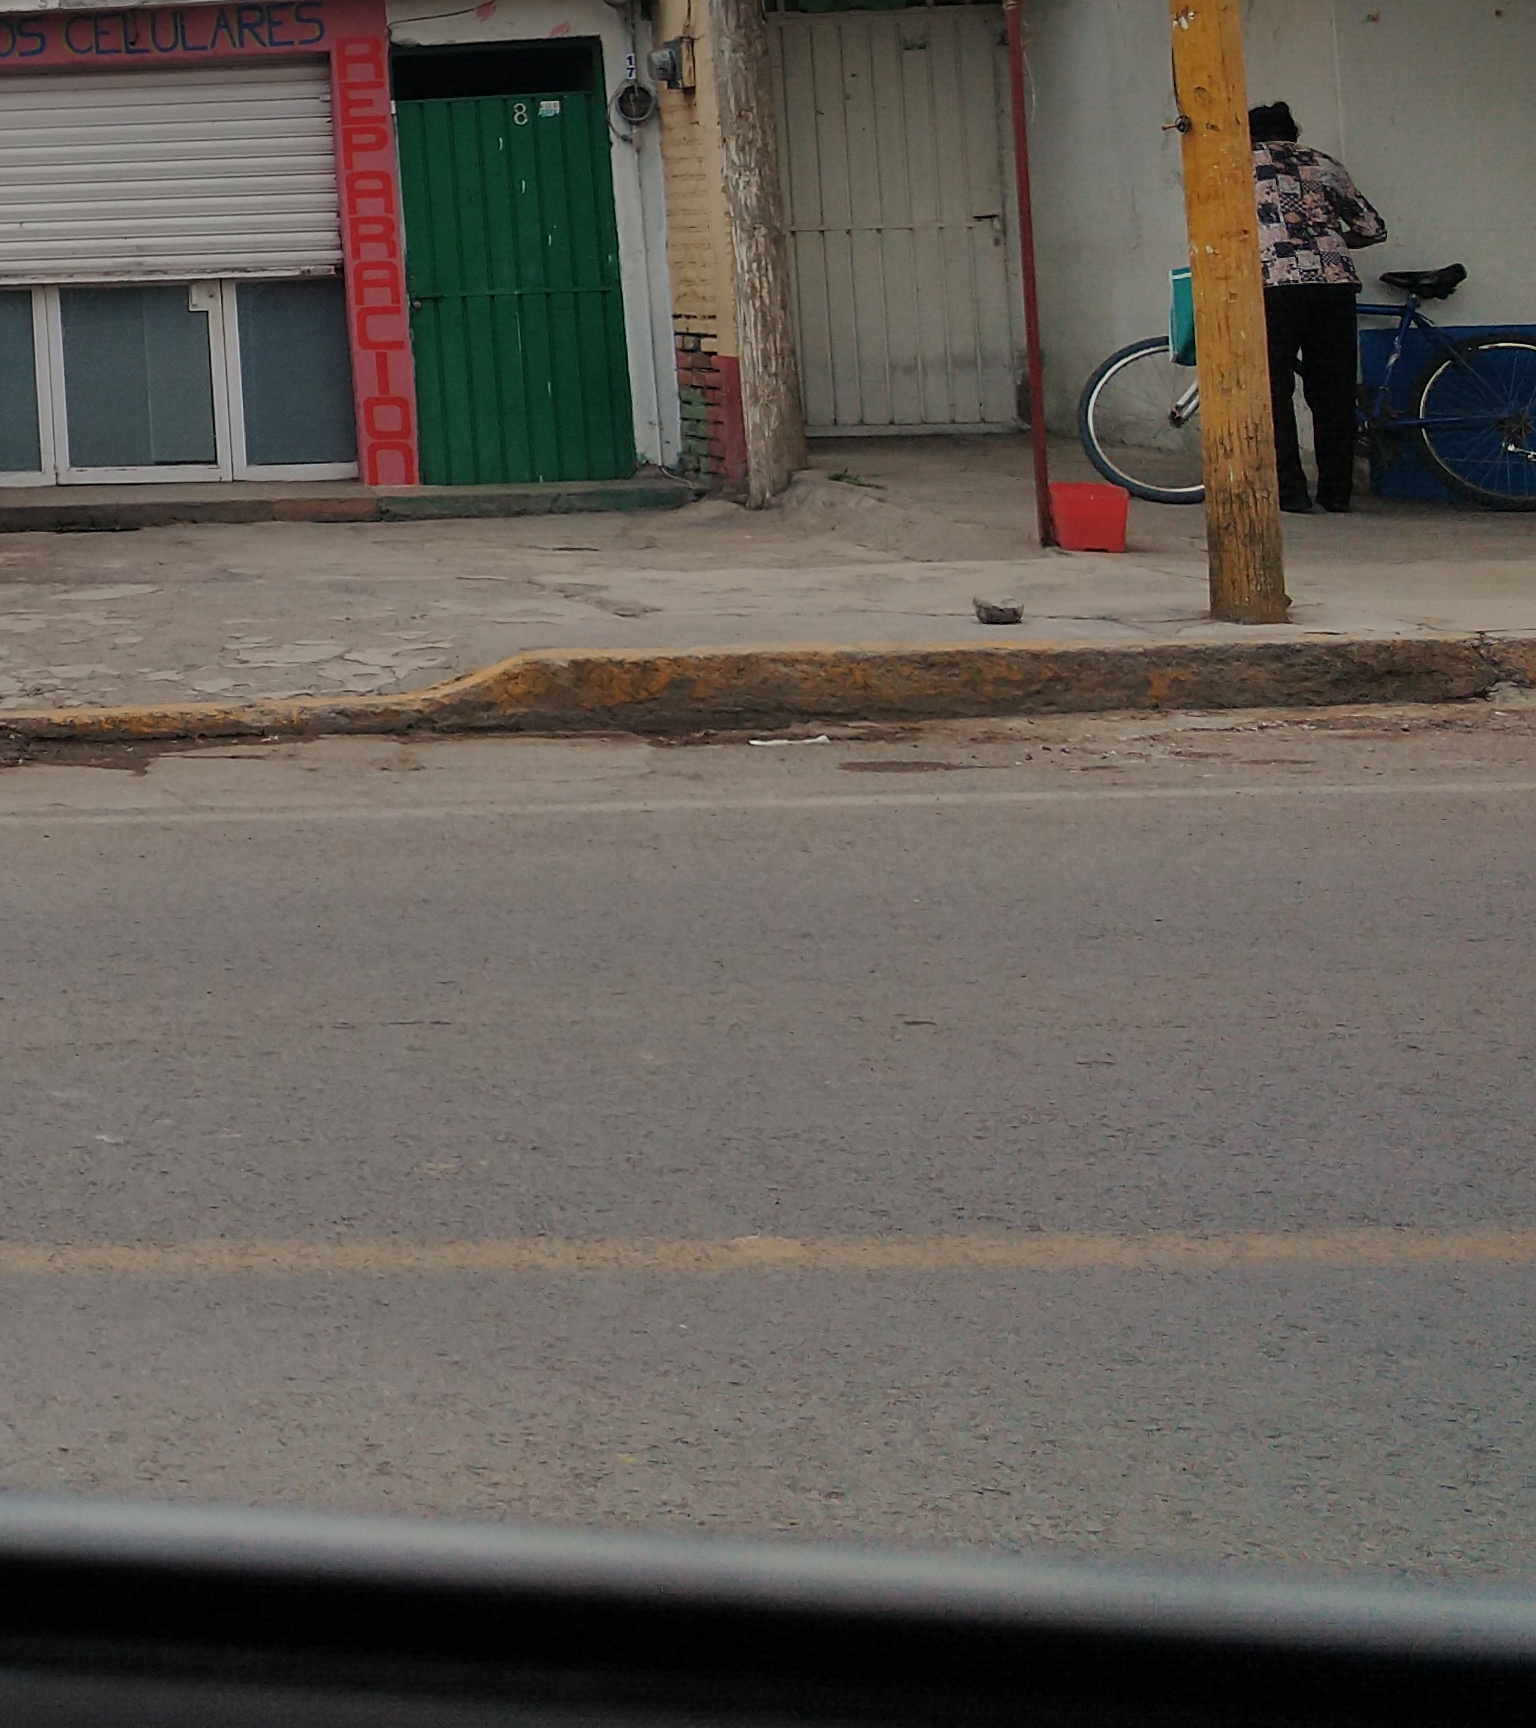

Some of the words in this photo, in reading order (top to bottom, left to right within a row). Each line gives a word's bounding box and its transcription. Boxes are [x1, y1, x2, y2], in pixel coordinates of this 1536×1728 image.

[63, 2, 325, 55] CELULARES
[513, 102, 529, 126] 8
[335, 35, 415, 486] REPARACION
